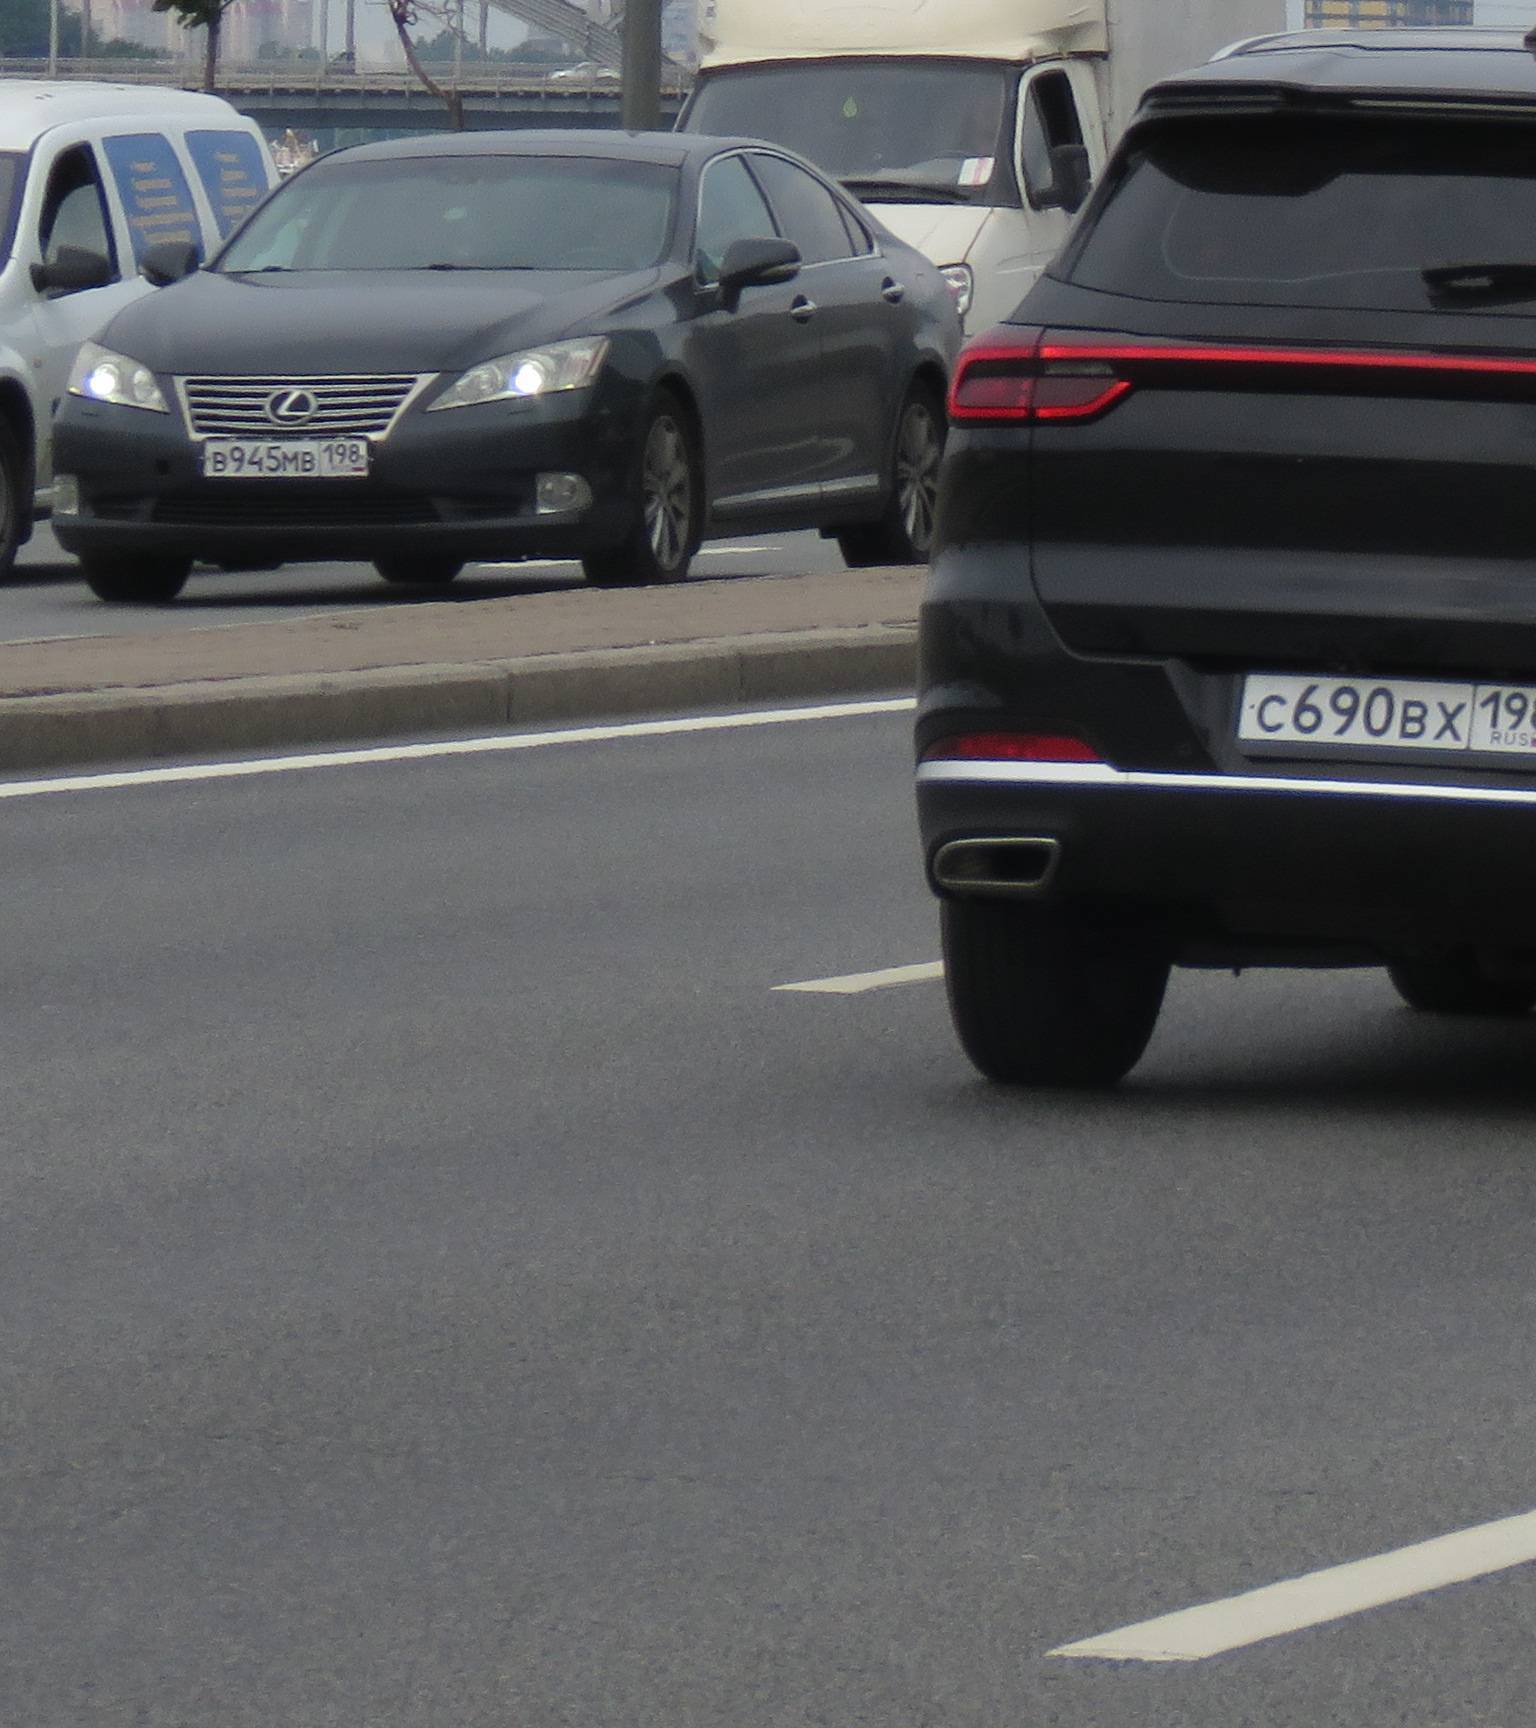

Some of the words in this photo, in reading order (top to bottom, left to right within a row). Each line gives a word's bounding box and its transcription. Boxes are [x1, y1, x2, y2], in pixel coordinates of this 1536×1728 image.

[212, 445, 316, 472] В945МВ
[323, 443, 361, 464] 198
[1257, 684, 1467, 742] С690ВХ
[1489, 732, 1530, 747] RUS
